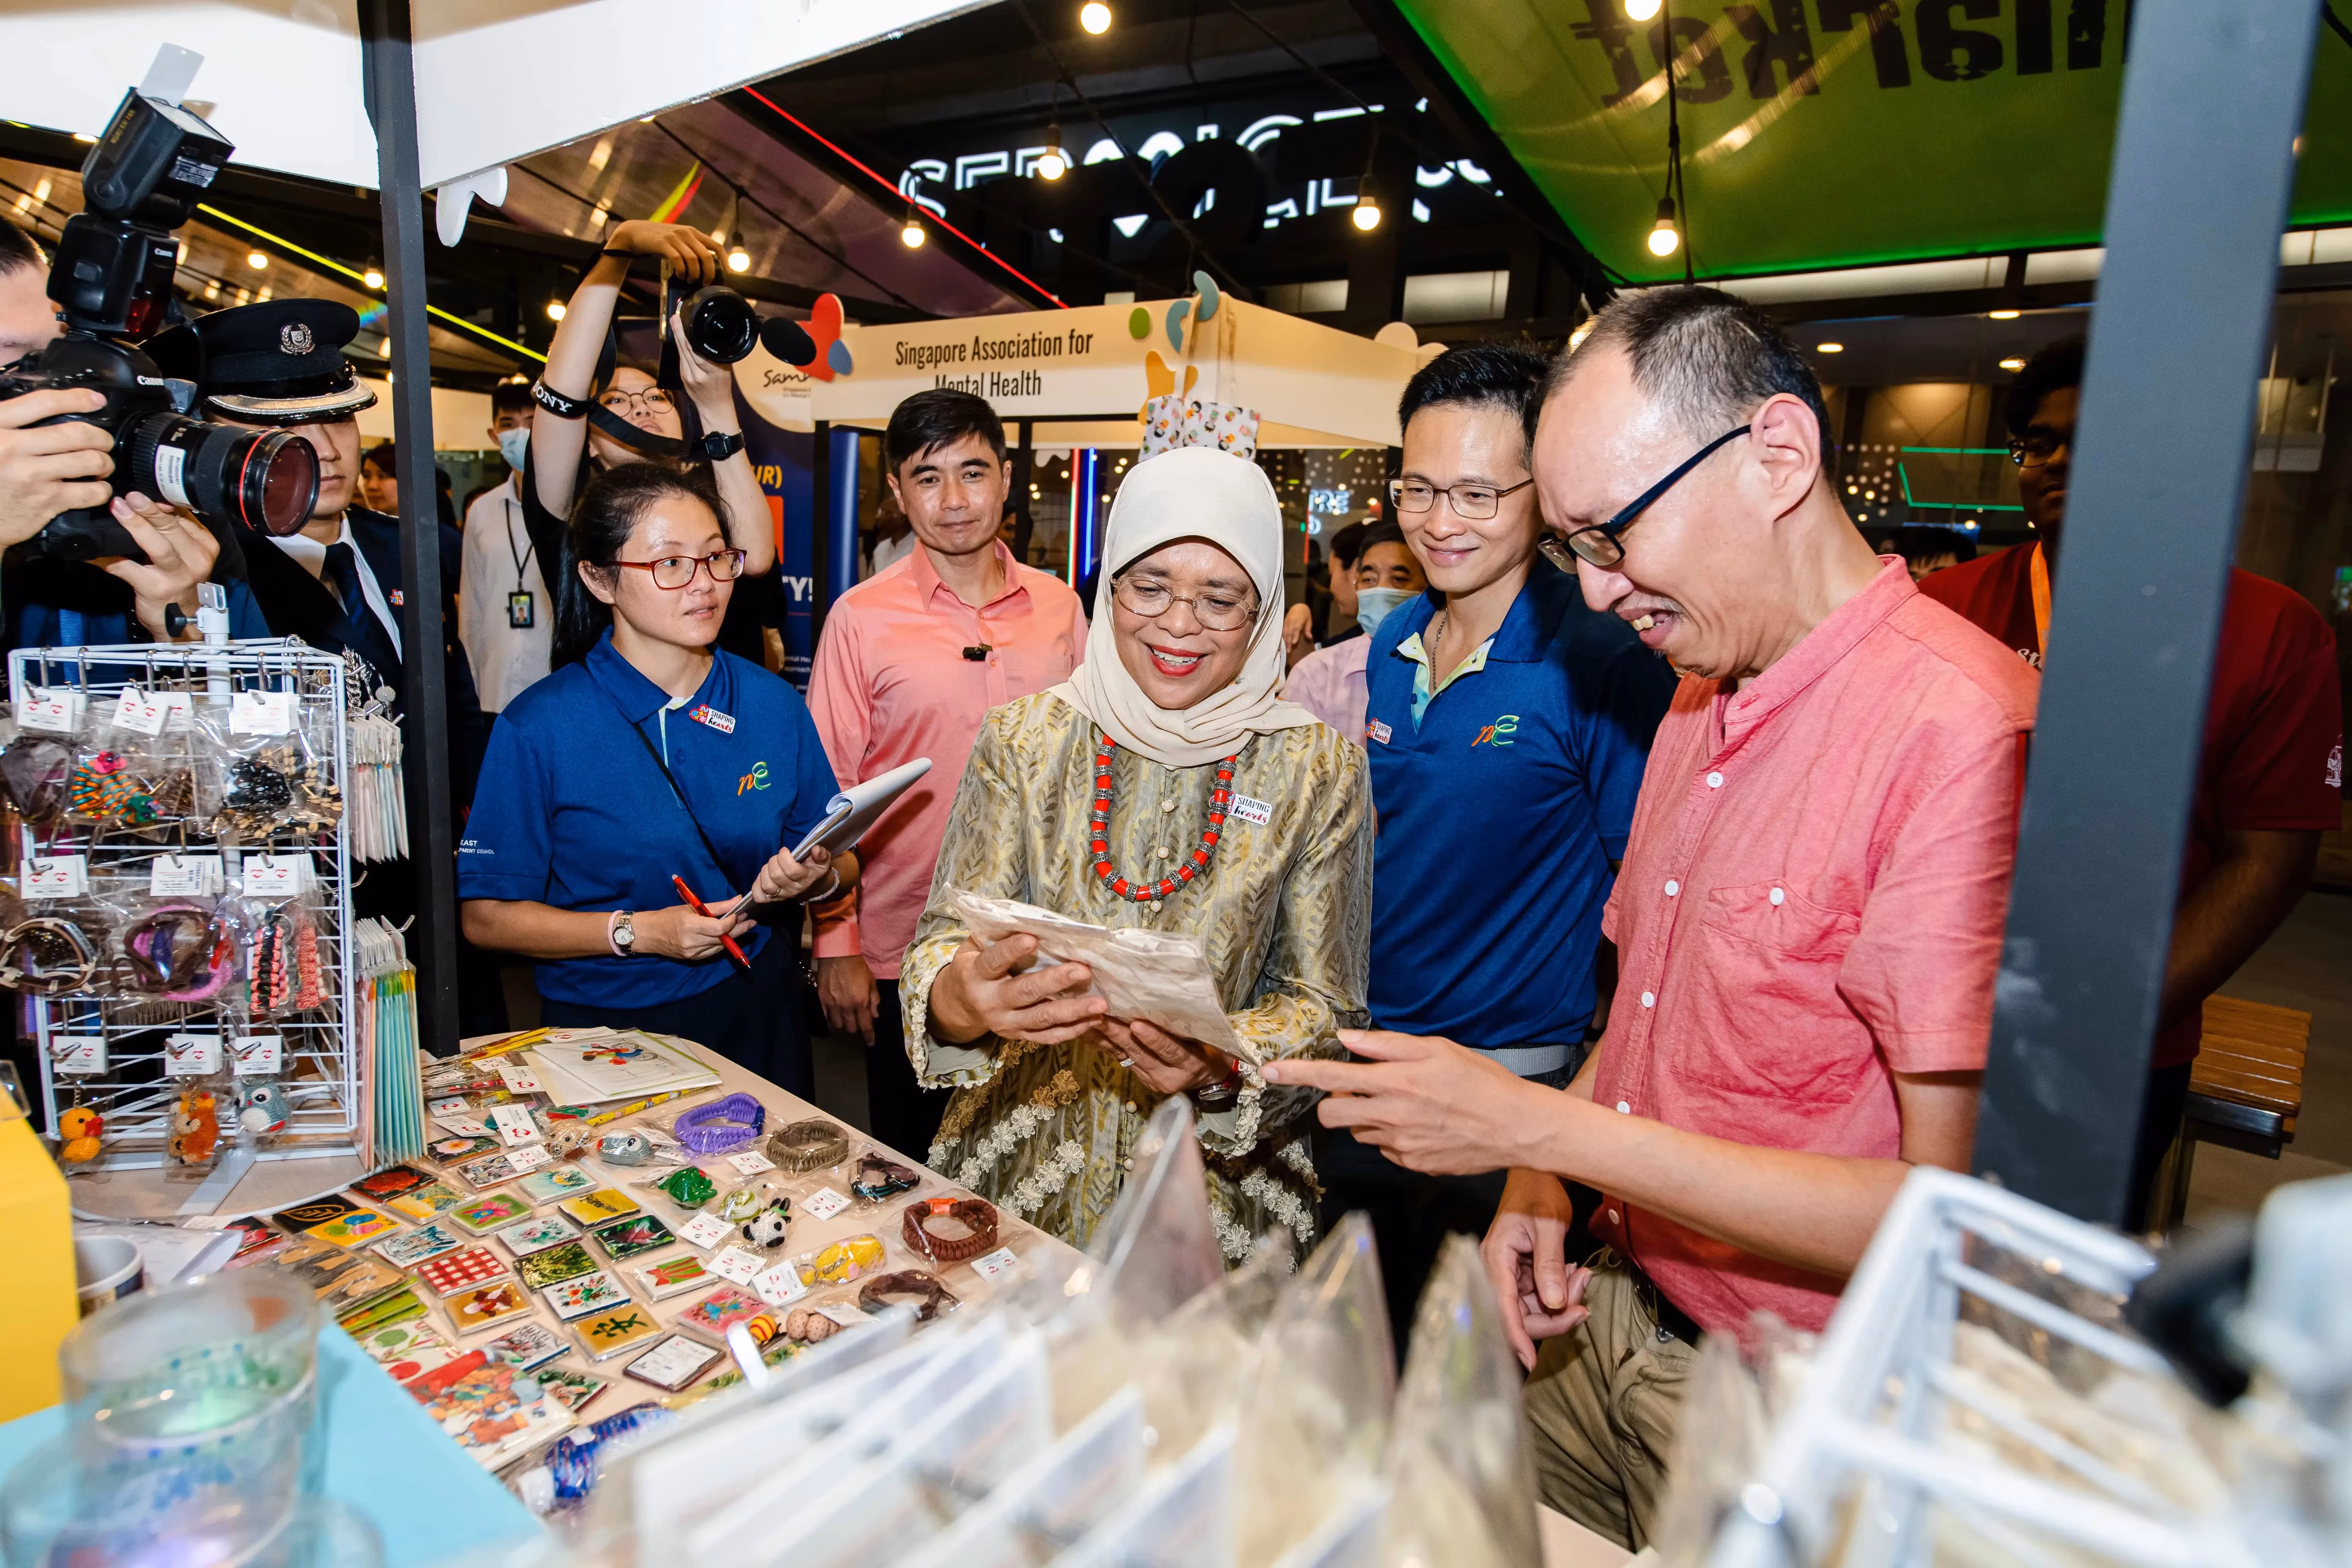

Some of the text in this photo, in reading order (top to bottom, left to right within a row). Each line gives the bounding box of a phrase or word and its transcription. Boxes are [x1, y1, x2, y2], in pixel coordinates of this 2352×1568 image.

[896, 329, 1093, 370] Singapore Association for
[990, 369, 1041, 397] Health
[534, 381, 572, 412] SONY
[708, 717, 732, 733] hearts
[711, 711, 733, 724] SHAPING
[1375, 730, 1388, 743] hearts
[1377, 723, 1390, 734] SHAPING
[1238, 797, 1270, 812] SHAPING
[1234, 805, 1267, 824] hearts
